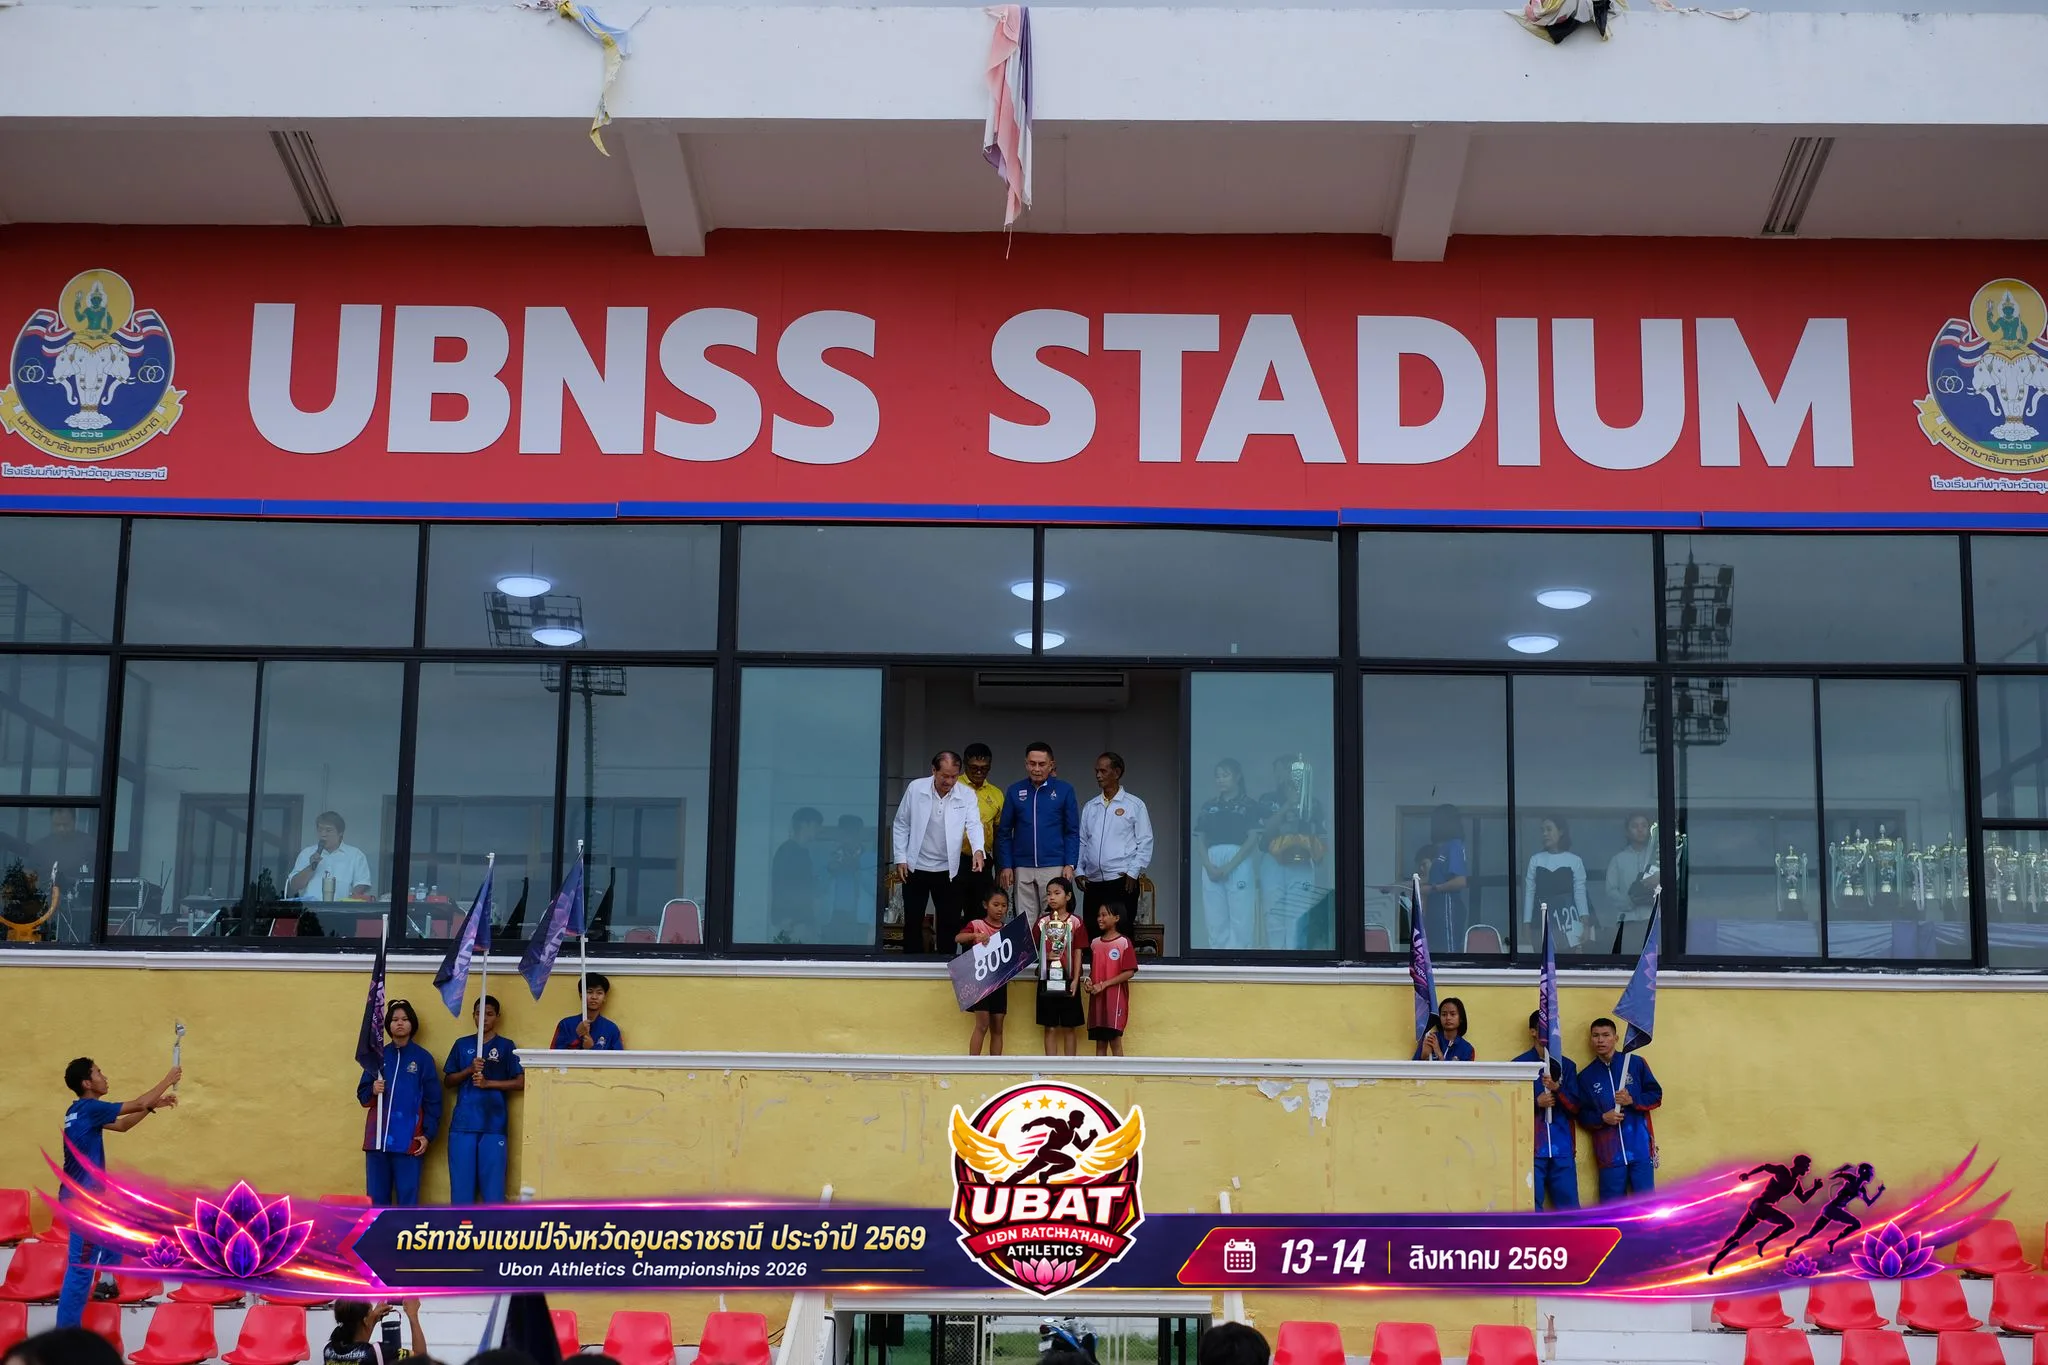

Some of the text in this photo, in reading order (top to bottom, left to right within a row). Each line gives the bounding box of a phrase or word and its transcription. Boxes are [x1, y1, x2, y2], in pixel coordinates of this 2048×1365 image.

[248, 302, 1854, 470] UBNSS STADIUM
[3, 464, 166, 481] โรงเรียนกีฬาจังหวัดอุบลราชธานี
[974, 937, 1013, 981] 800
